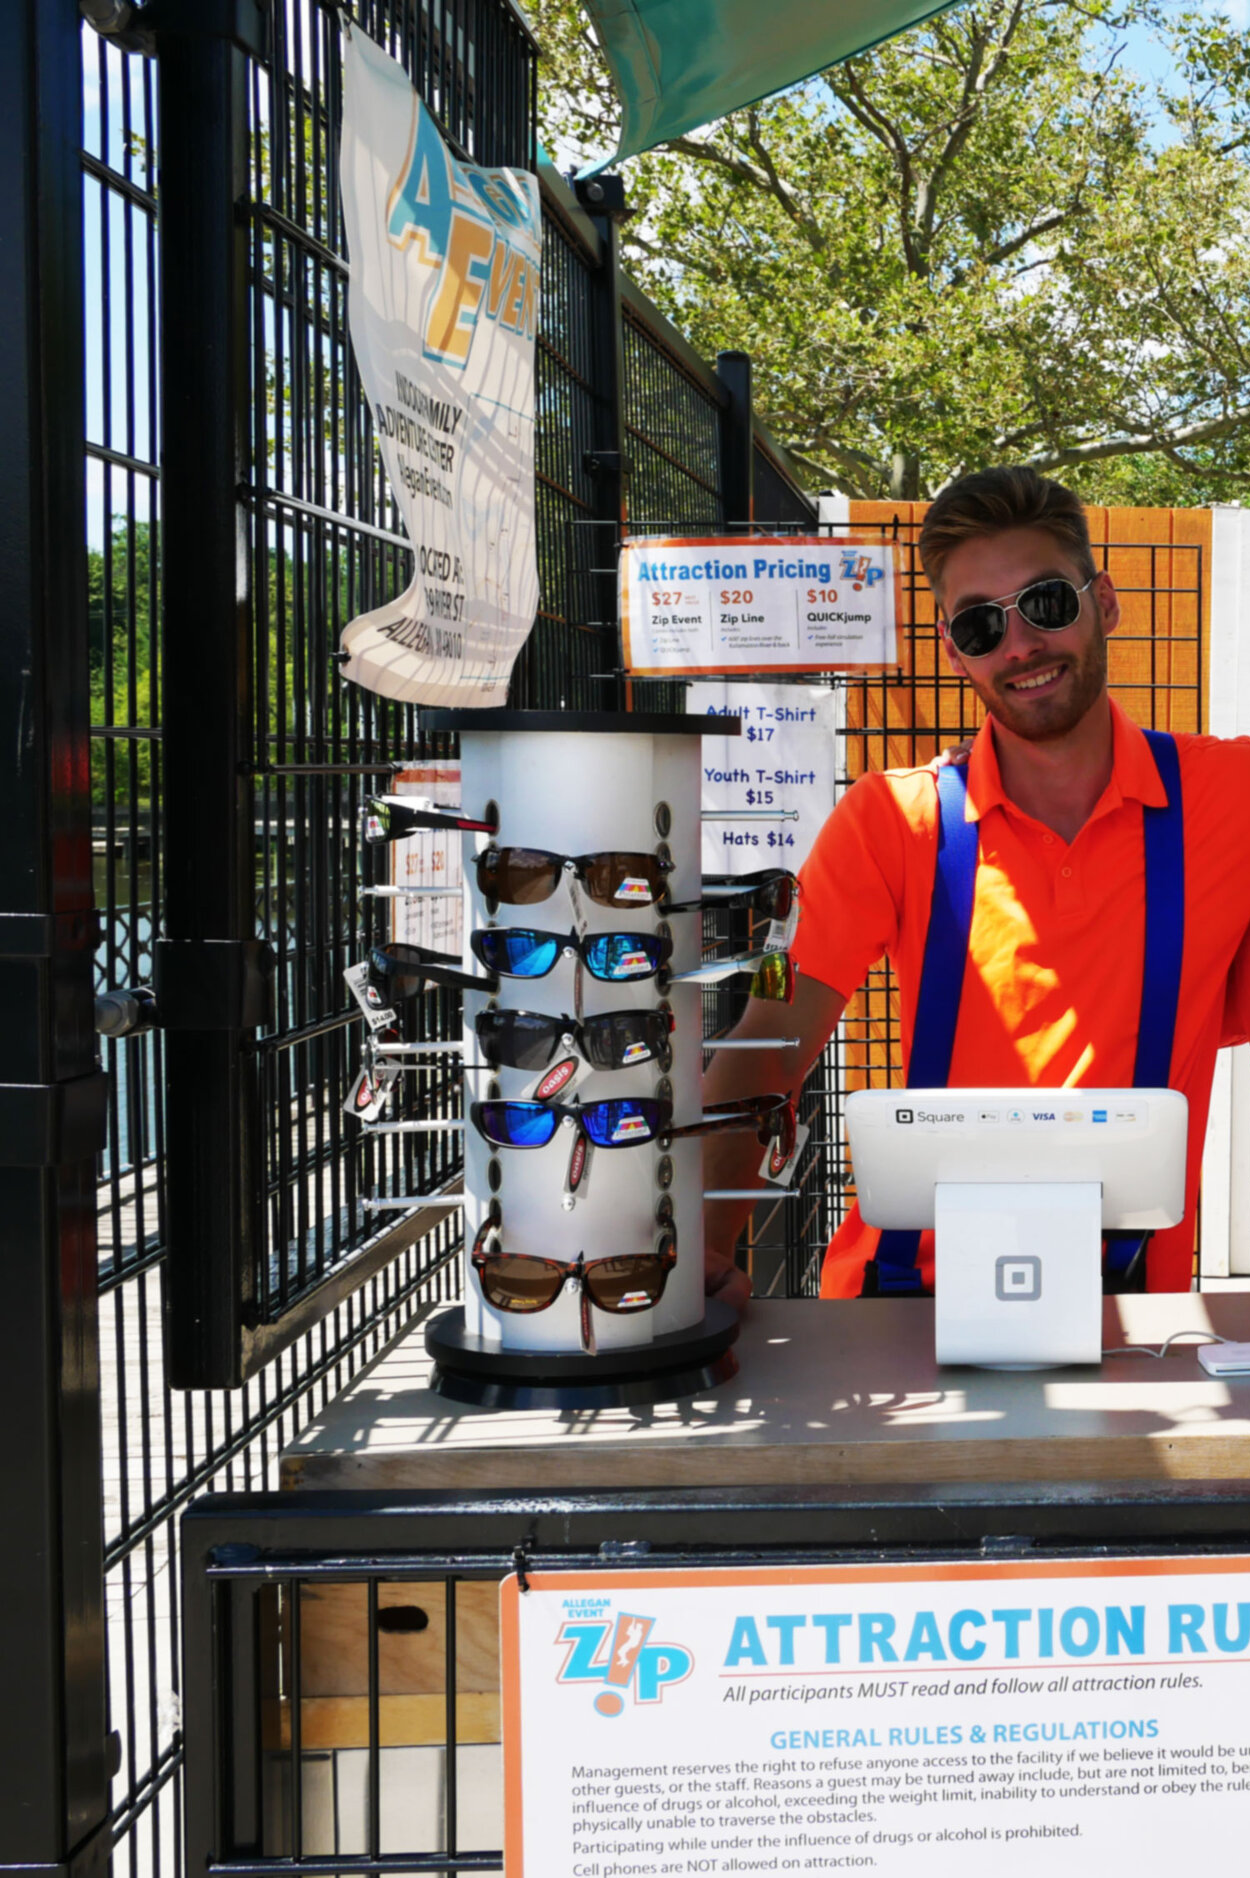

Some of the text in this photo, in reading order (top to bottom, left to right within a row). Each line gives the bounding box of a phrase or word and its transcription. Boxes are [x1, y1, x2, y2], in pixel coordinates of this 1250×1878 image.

[423, 200, 541, 371] EVEN
[638, 558, 831, 583] Attraction Pricing
[652, 591, 682, 606] $27
[720, 590, 753, 605] $20
[807, 589, 838, 604] $10
[652, 615, 702, 626] Zip Event
[720, 613, 765, 625] Zip Line
[807, 611, 872, 624] QUICKjump
[706, 704, 816, 721] Adult T-Shirt
[746, 725, 774, 742] $17
[704, 768, 816, 784] Youth T-Shirt
[746, 788, 774, 805] $15
[722, 830, 795, 848] Hats $14
[542, 1066, 569, 1094] oasis
[917, 1111, 965, 1125] Square
[1032, 1112, 1056, 1121] VISA
[562, 1597, 611, 1609] ALLEGAN
[567, 1607, 604, 1618] EVENT
[724, 1607, 1146, 1666] ATTRACTION
[723, 1673, 1202, 1704] All participants MUST read and follow all attraction rules.
[769, 1719, 1159, 1750] GENERAL RULES & REGULATIONS
[571, 1765, 667, 1780] Management
[672, 1765, 731, 1775] reserves
[734, 1761, 758, 1772] the
[762, 1760, 795, 1775] right
[800, 1761, 815, 1771] to
[819, 1758, 862, 1769] refuse
[866, 1759, 918, 1771] anyone
[922, 1757, 967, 1767] access
[971, 1755, 986, 1765] to
[989, 1753, 1013, 1765] the
[1016, 1751, 1063, 1765] facility
[1066, 1750, 1075, 1761] if
[1078, 1753, 1099, 1761] we
[1103, 1748, 1153, 1760] believe
[1157, 1749, 1165, 1759] it
[1169, 1745, 1213, 1758] would
[1217, 1745, 1235, 1756] be
[571, 1784, 610, 1796] other
[614, 1784, 664, 1797] guests,
[668, 1784, 683, 1792] or
[687, 1780, 711, 1792] the
[715, 1778, 748, 1791] staff.
[753, 1778, 811, 1789] Reasons
[827, 1777, 866, 1791] guest
[871, 1777, 901, 1788] may
[905, 1773, 922, 1784] be
[926, 1771, 974, 1784] turned
[978, 1773, 1014, 1784] away
[1018, 1768, 1073, 1781] include,
[1077, 1767, 1100, 1779] but
[1104, 1769, 1127, 1778] are
[1130, 1766, 1154, 1777] not
[1158, 1763, 1206, 1776] limited
[1210, 1765, 1227, 1775] to,
[572, 1801, 639, 1813] influence
[642, 1799, 657, 1811] of
[661, 1799, 702, 1813] drugs
[706, 1800, 720, 1809] or
[724, 1795, 780, 1808] alcohol,
[784, 1793, 857, 1807] exceeding
[861, 1792, 885, 1804] the
[888, 1790, 937, 1805] weight
[941, 1789, 976, 1801] limit,
[980, 1787, 1037, 1801] inability
[1040, 1788, 1055, 1797] to
[1059, 1782, 1139, 1797] understand
[1143, 1785, 1157, 1794] or
[1161, 1781, 1196, 1795] obey
[1200, 1780, 1223, 1792] the
[572, 1810, 876, 1834] physically unable to traverse the obstacles.
[572, 1824, 1081, 1855] Participating while under the influence of drugs or alcohol is prohibited.
[572, 1857, 876, 1878] Cell phones are NOT allowed on attraction.
